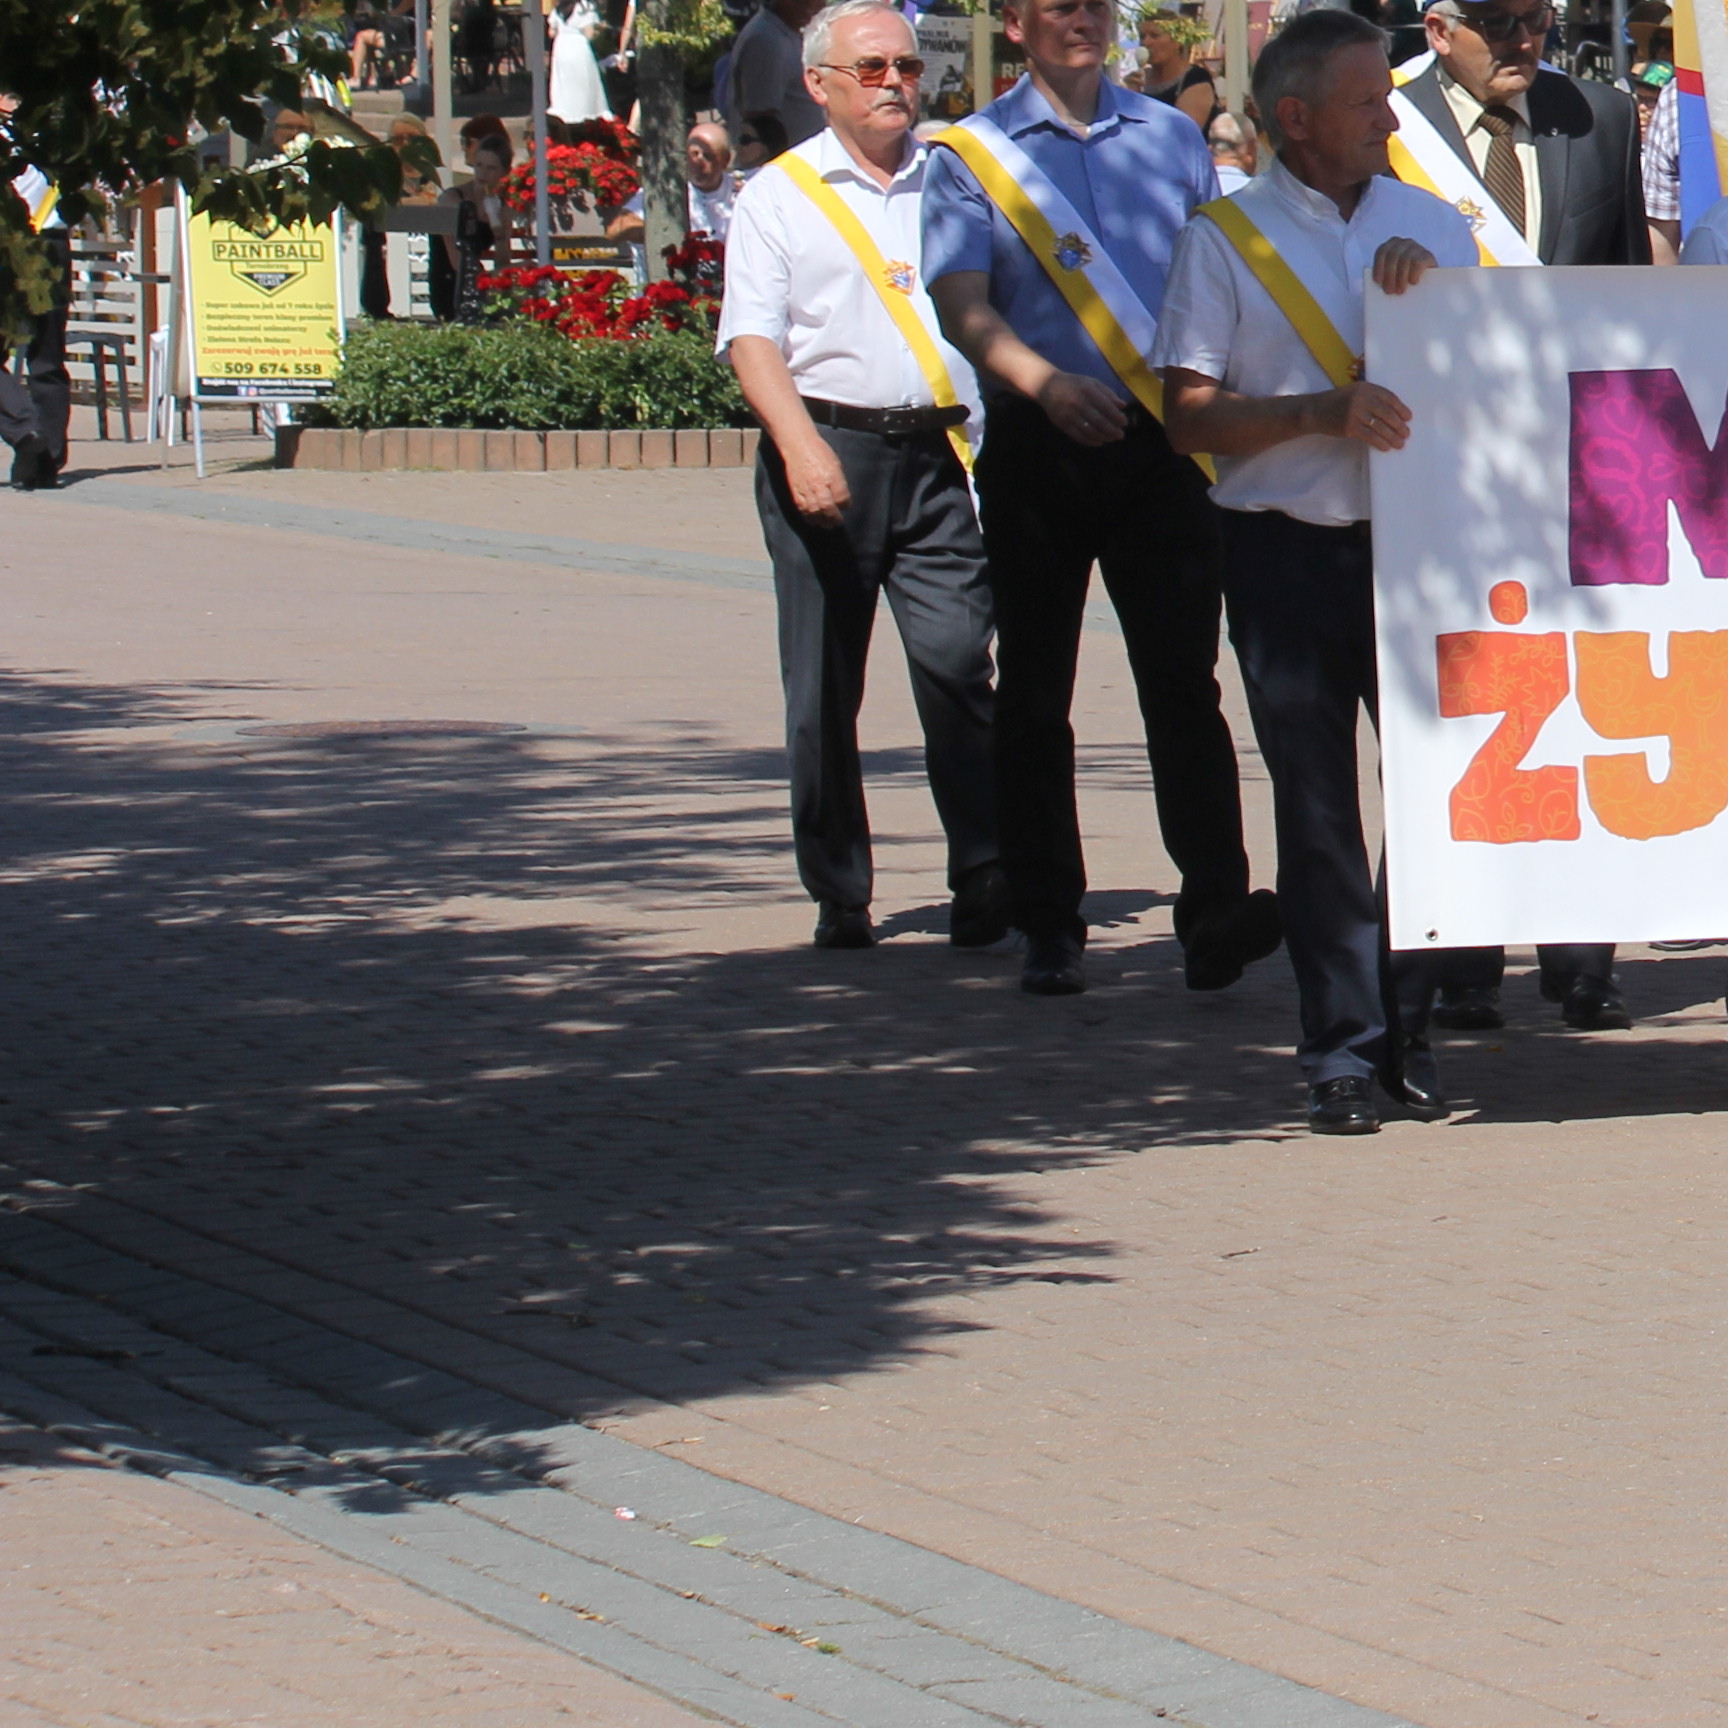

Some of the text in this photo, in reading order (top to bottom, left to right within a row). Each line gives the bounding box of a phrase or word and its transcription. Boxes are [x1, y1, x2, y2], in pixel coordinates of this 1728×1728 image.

[216, 243, 319, 259] PAINTBALL
[224, 362, 322, 375] 509 674 558
